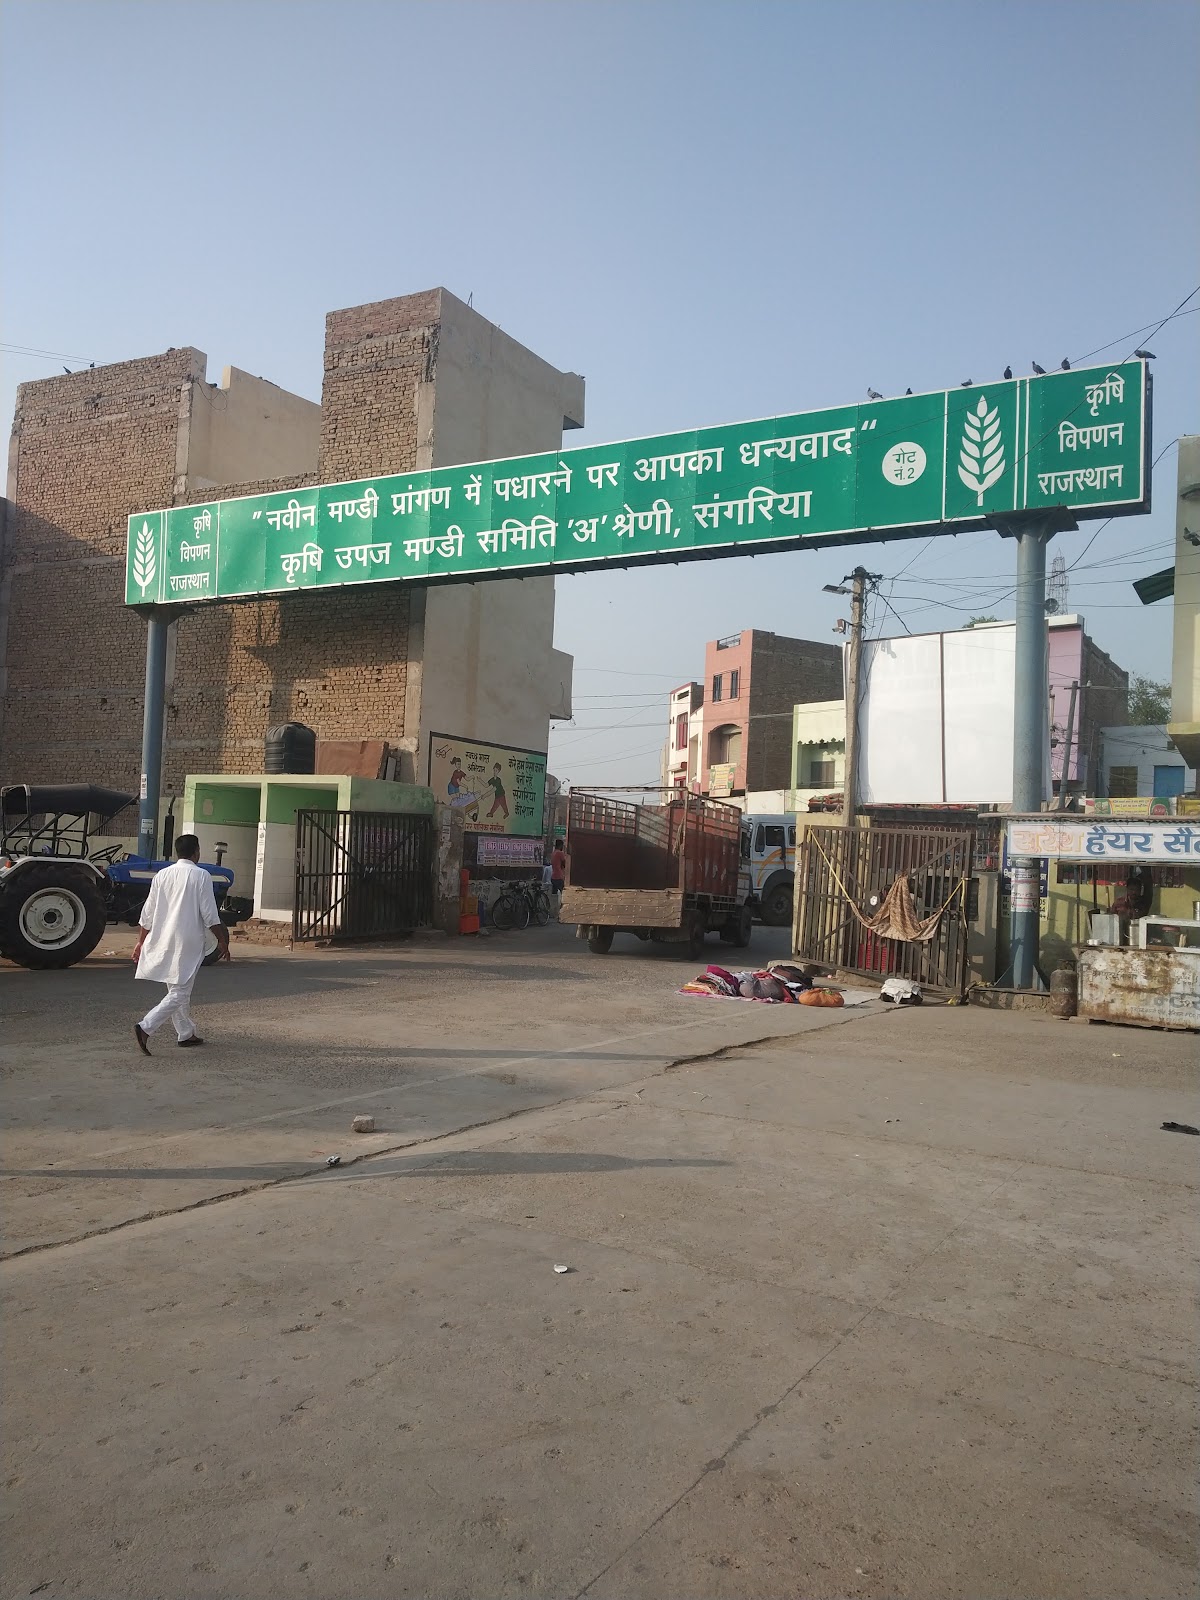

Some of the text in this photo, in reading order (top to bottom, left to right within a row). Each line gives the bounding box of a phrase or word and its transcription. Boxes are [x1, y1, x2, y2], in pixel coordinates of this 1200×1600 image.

[1085, 371, 1126, 417] कृषि
[1058, 420, 1125, 453] विपणन
[893, 447, 916, 464] गेट
[328, 487, 379, 523] मण्डी
[391, 483, 452, 515] प्रांगण
[464, 474, 482, 506] में
[493, 460, 573, 501] पधारने
[586, 462, 621, 489] पर
[633, 446, 725, 482] आपका
[1038, 464, 1124, 496] राजस्थान
[193, 509, 212, 541] कृषि
[281, 543, 324, 583] कृषि
[334, 541, 392, 570] उपज
[403, 525, 465, 562] मण्डी
[477, 515, 558, 553] समिति
[693, 486, 814, 529] संगरिया
[180, 541, 211, 563] विपणन
[170, 571, 210, 592] राजस्थान
[1086, 825, 1155, 855] हैयर
